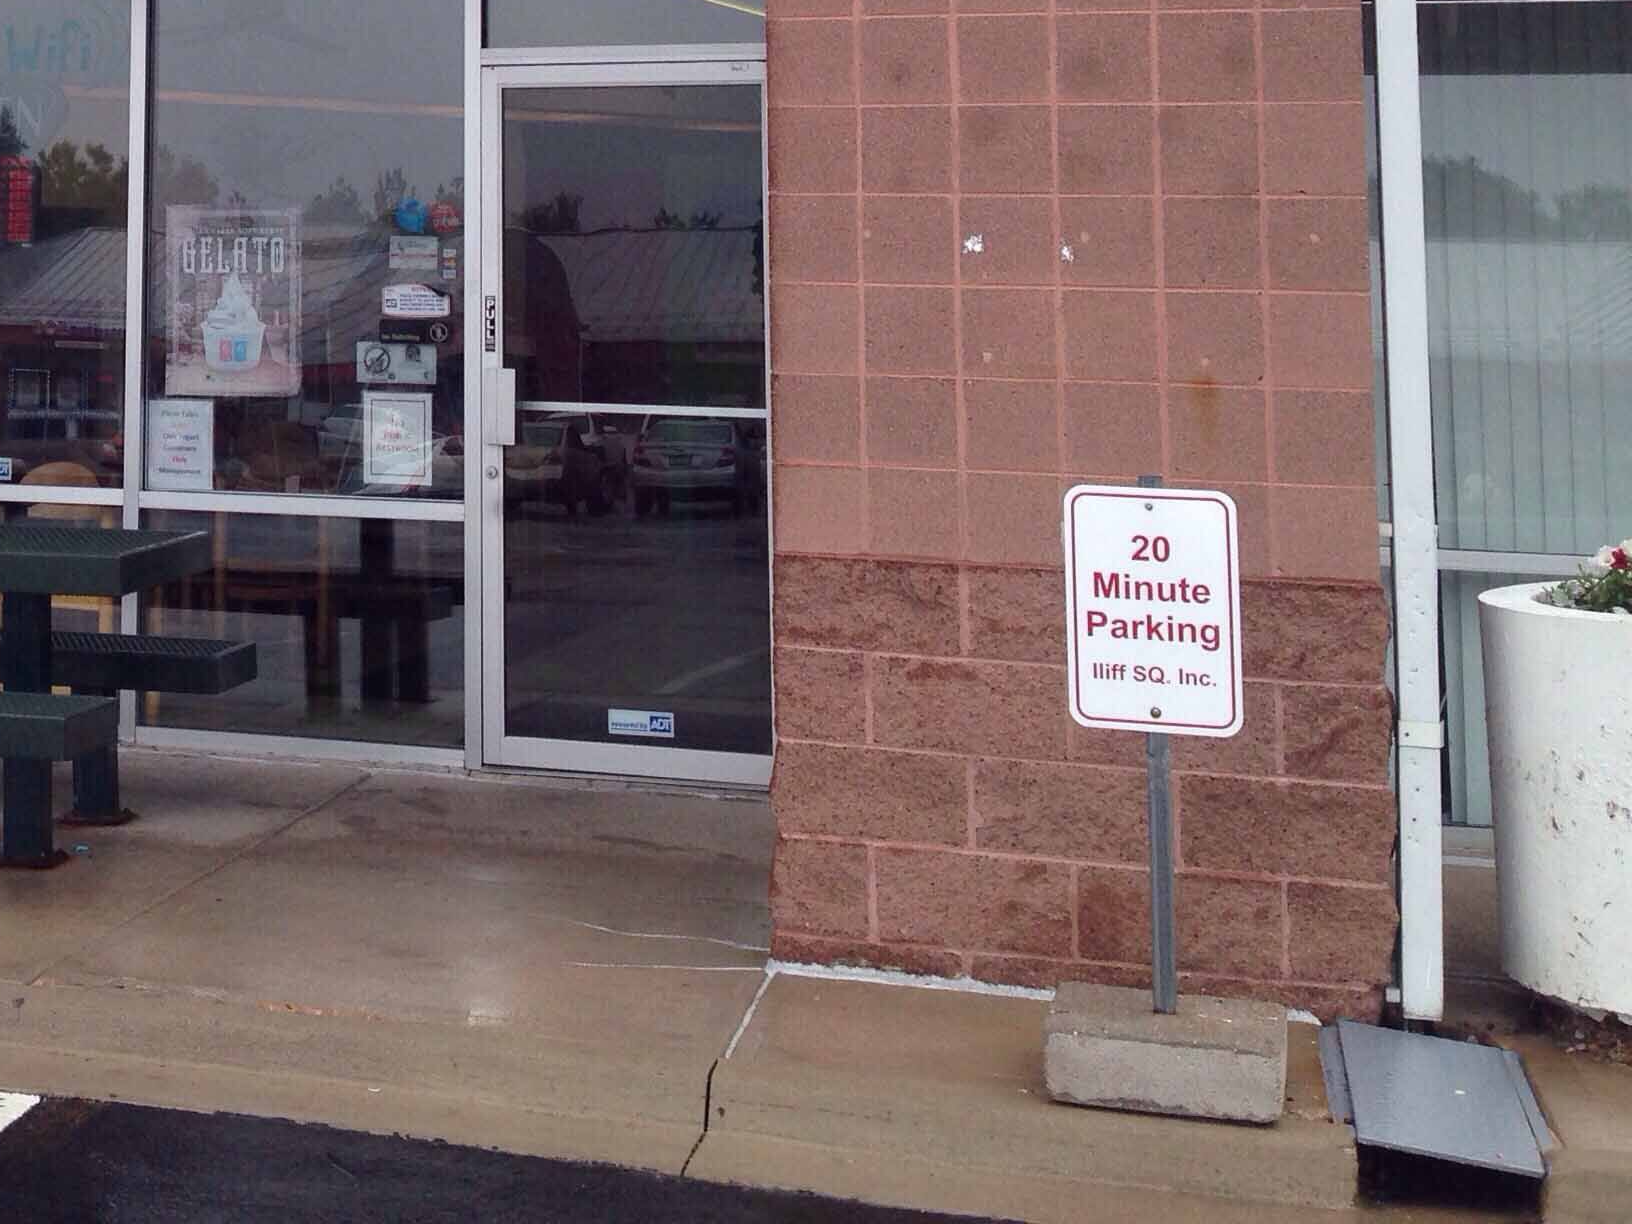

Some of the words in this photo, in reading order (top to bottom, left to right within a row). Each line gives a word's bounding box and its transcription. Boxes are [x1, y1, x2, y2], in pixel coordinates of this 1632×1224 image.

[182, 236, 286, 275] GELATO
[486, 300, 495, 339] PULL
[1131, 535, 1171, 562] 20
[1092, 572, 1211, 604] Minute
[1086, 611, 1220, 652] Parking
[1133, 665, 1171, 684] SQ.
[1179, 669, 1217, 687] Inc.
